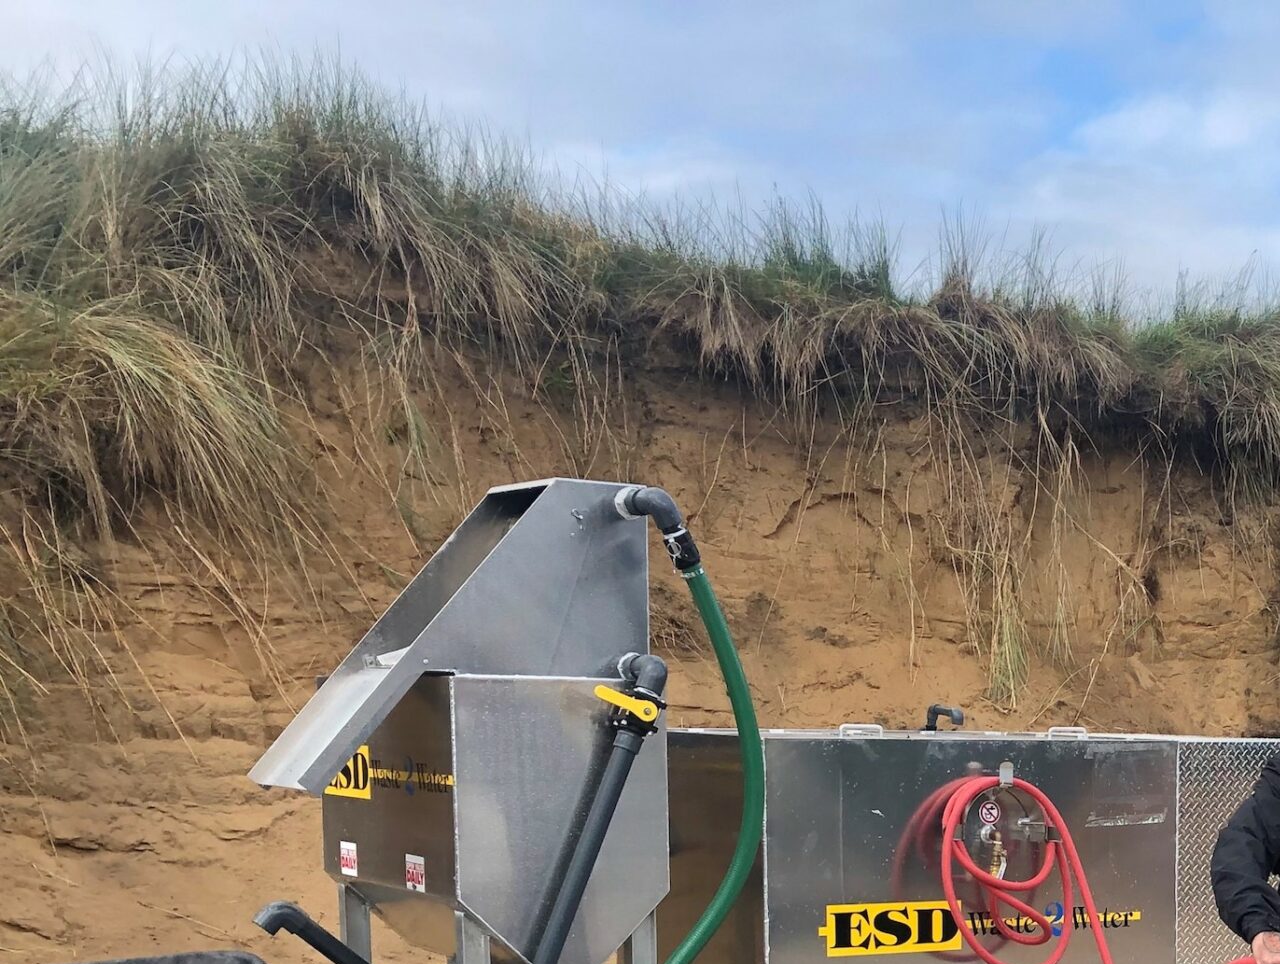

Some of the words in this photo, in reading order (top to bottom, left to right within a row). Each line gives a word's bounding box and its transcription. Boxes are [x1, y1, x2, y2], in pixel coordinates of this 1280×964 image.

[330, 752, 369, 791] SD
[416, 762, 450, 793] Water
[341, 855, 356, 871] DAILY
[406, 868, 424, 886] DAILY
[830, 907, 960, 951] ESD
[1072, 906, 1133, 930] Wter
